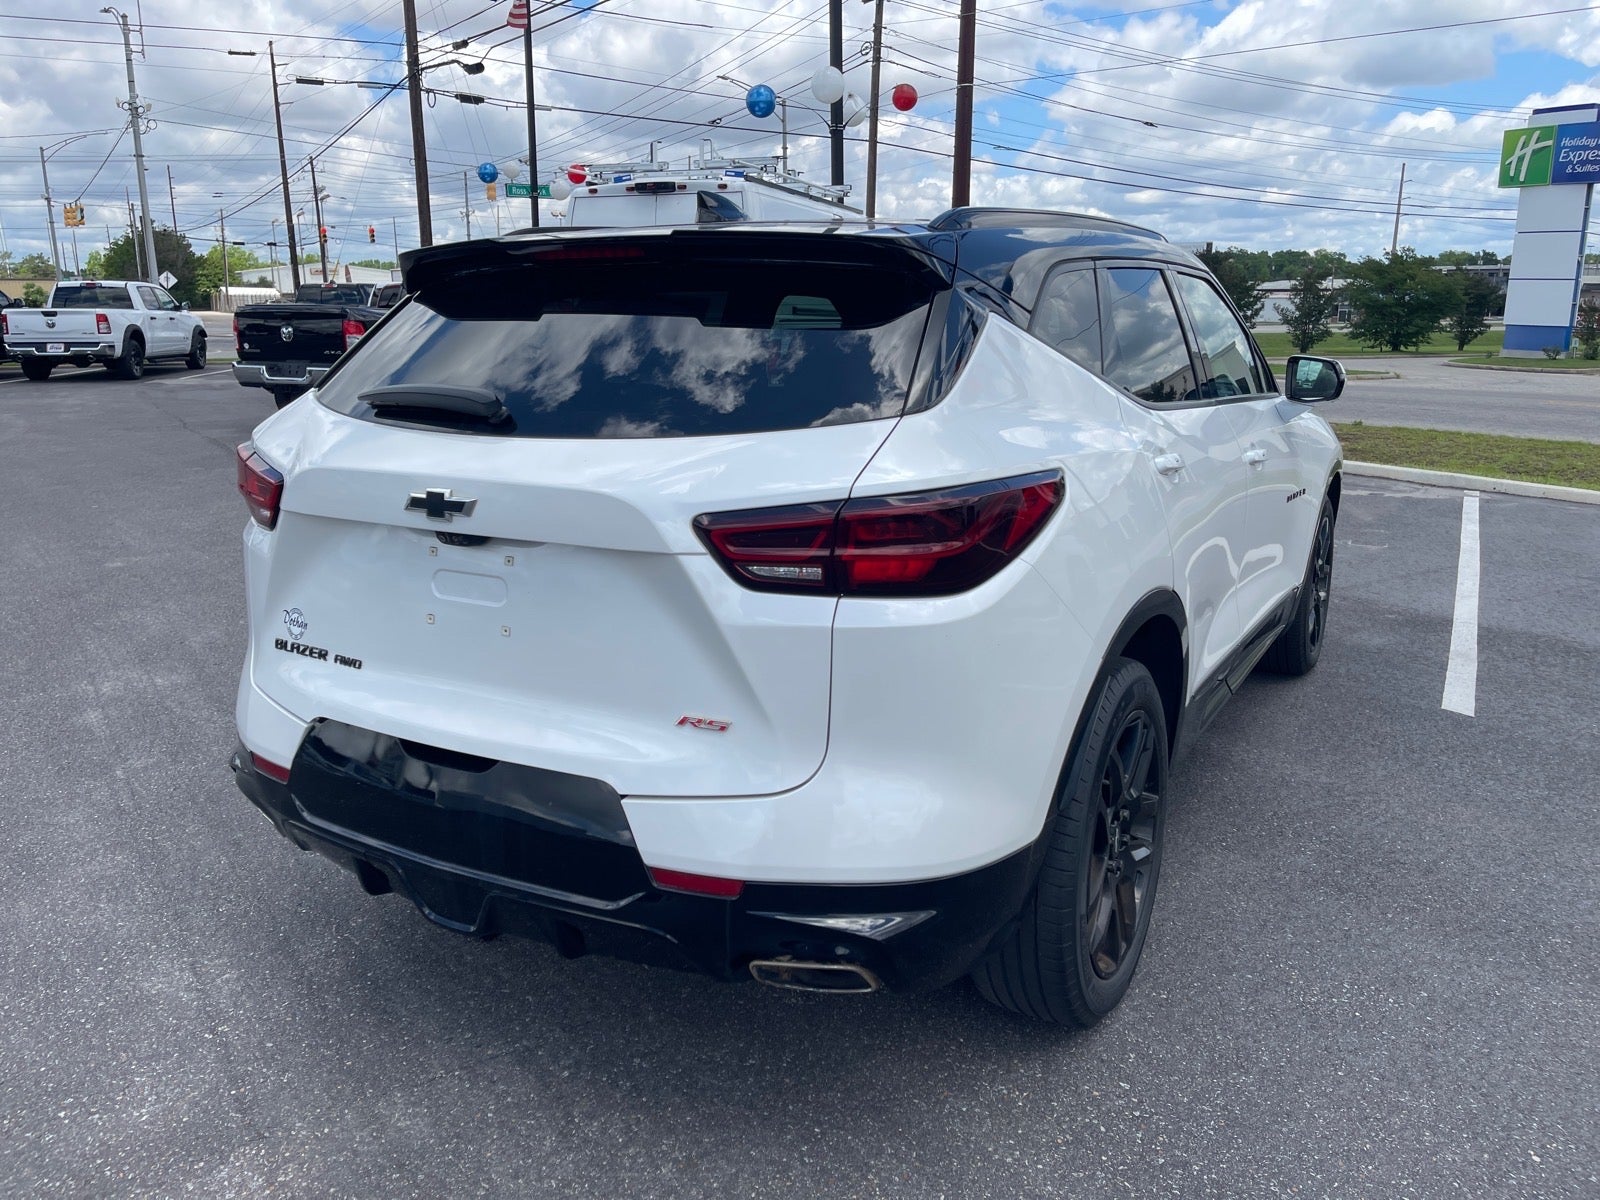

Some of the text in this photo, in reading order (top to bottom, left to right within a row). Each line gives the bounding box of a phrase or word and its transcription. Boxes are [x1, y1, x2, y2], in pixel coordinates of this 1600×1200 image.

[1560, 136, 1598, 147] Holiday
[1565, 163, 1600, 173] & Suites
[512, 186, 527, 195] Ross
[283, 609, 308, 630] Dothan
[275, 638, 362, 670] BLAZER AWD
[675, 715, 732, 731] RS
